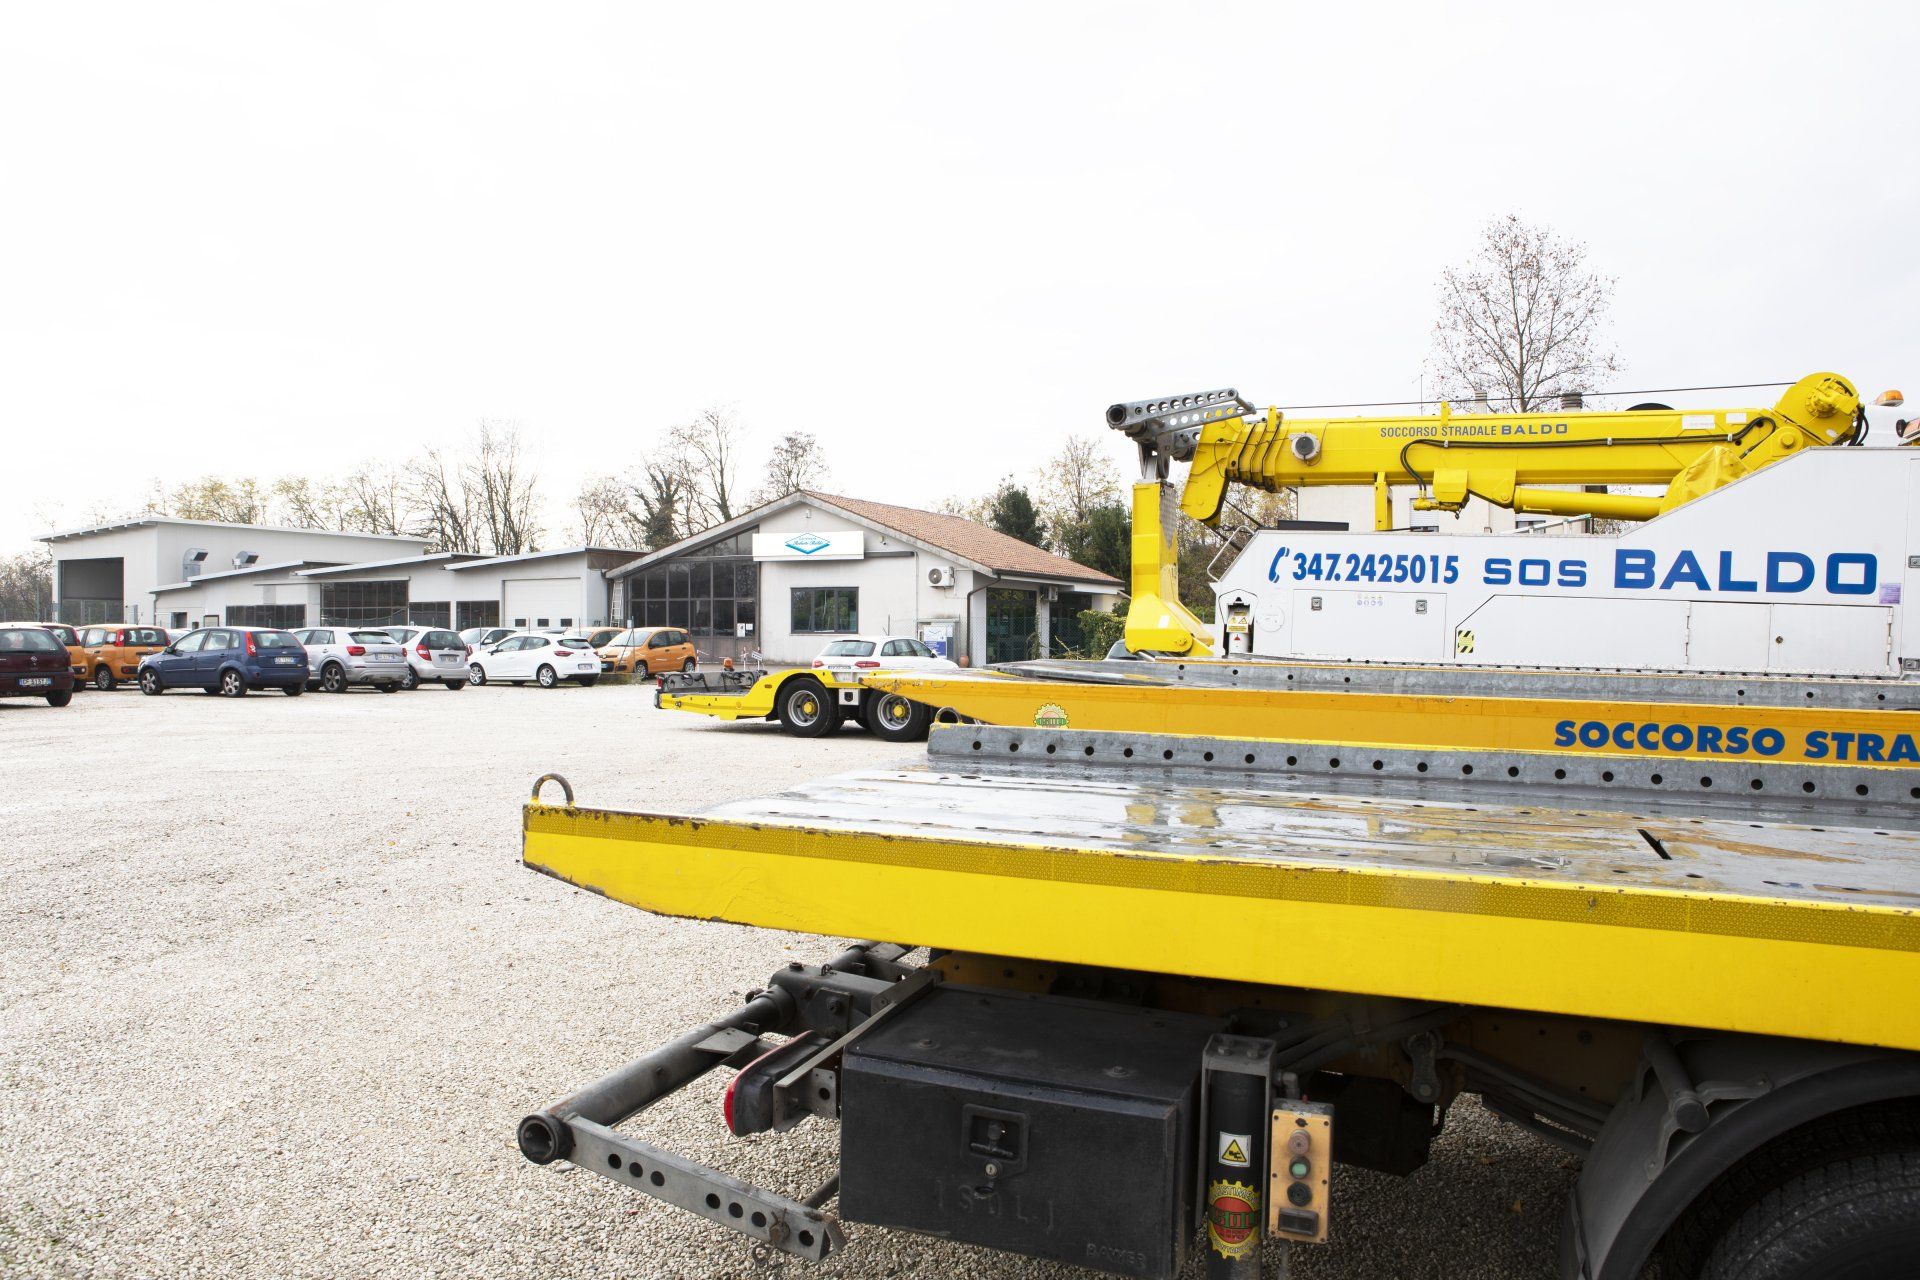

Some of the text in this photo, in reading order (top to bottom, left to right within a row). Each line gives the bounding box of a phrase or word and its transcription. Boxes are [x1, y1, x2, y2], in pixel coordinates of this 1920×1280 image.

[1380, 423, 1568, 438] SOCCORSO STRADALE BALDO
[1292, 552, 1459, 585] 347.2425015
[1483, 557, 1588, 588] SOS
[1614, 548, 1878, 596] BALDO
[1554, 719, 1920, 763] SOCCORSO STRA
